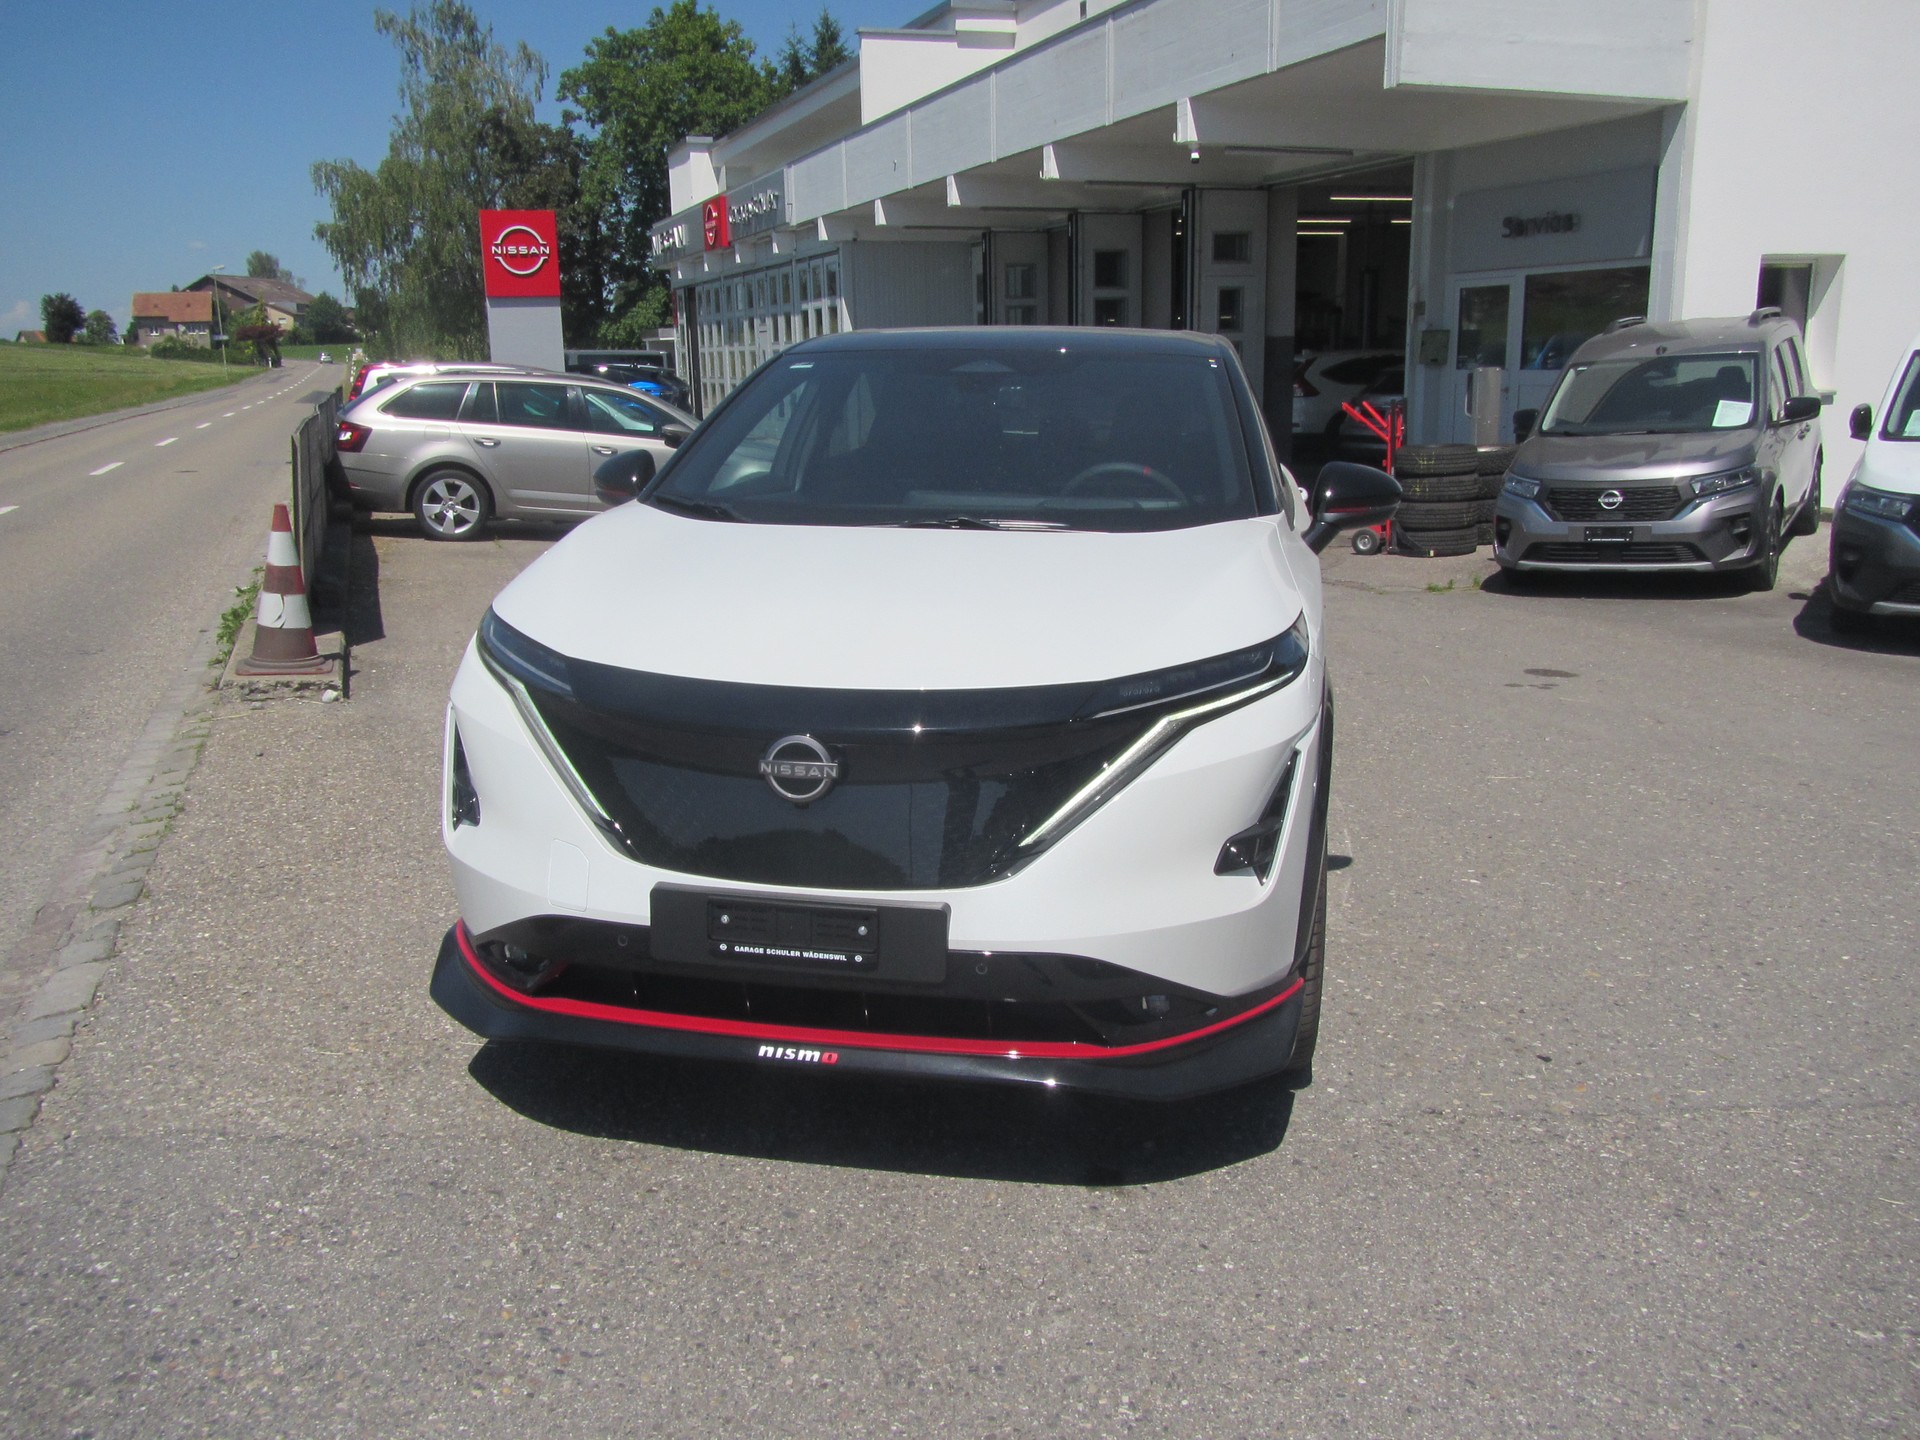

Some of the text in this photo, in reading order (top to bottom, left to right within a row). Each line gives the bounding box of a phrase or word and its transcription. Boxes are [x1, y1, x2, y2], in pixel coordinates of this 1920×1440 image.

[491, 246, 550, 255] NISSAN
[760, 762, 837, 778] NISSAN
[734, 945, 847, 961] GARAGE SCHULER WÄDENSWIL
[758, 1045, 839, 1065] nismo
